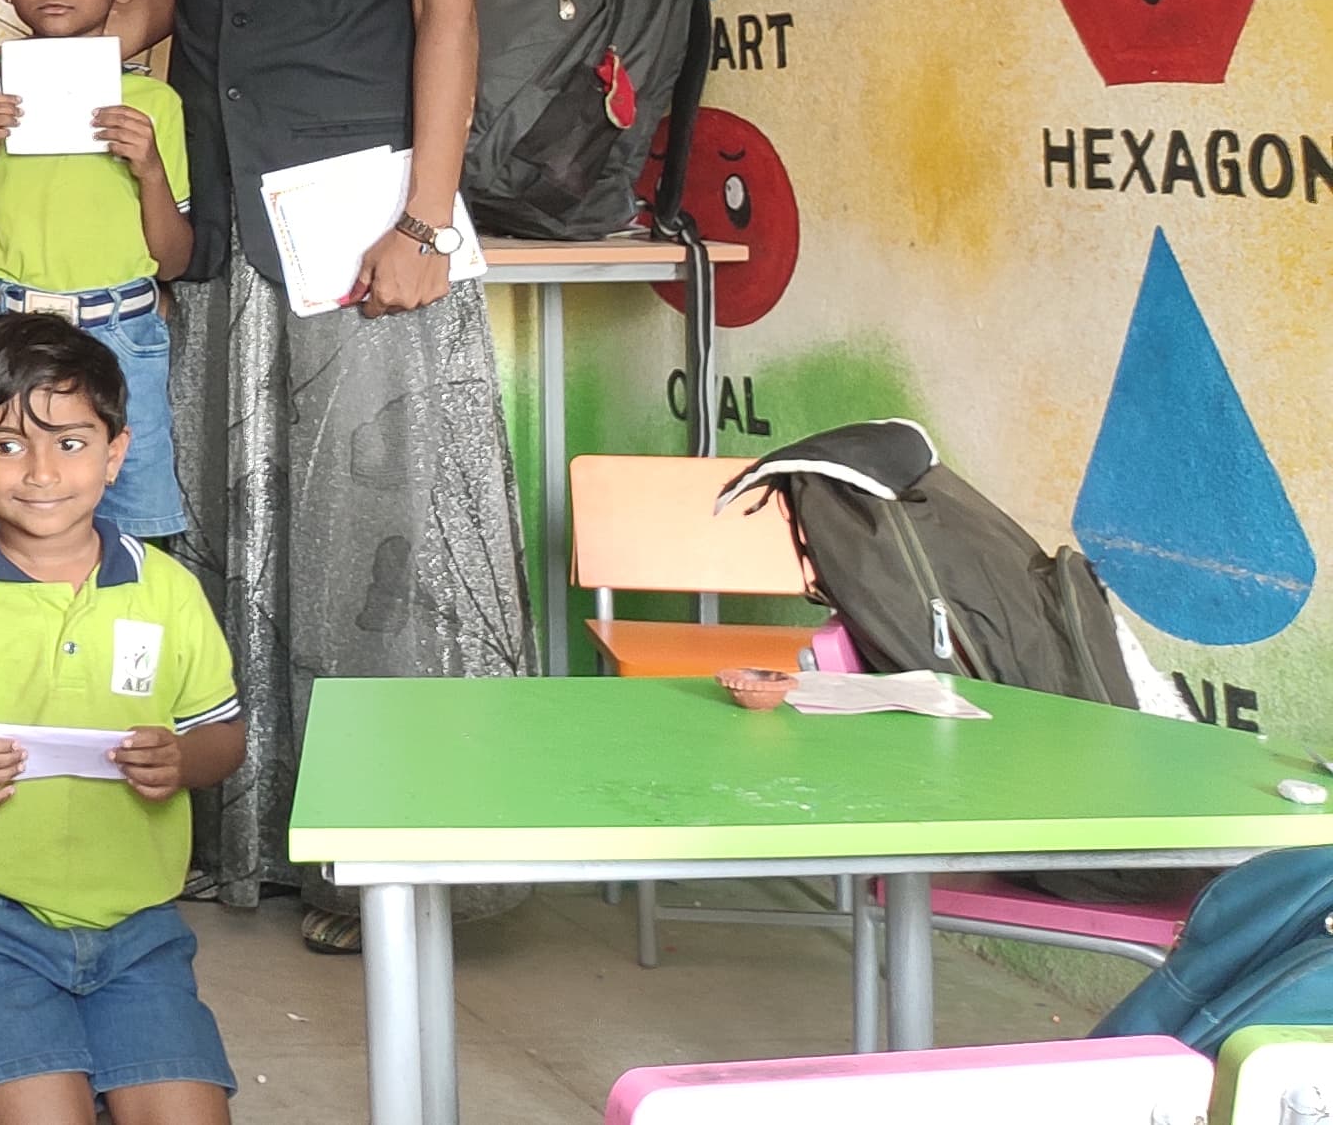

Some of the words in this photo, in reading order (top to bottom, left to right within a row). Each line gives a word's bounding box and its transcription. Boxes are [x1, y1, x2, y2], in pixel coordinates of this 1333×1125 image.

[710, 12, 794, 71] ART
[1042, 126, 1333, 204] HEXAGON
[667, 368, 772, 436] OAL
[1171, 671, 1262, 734] NE
